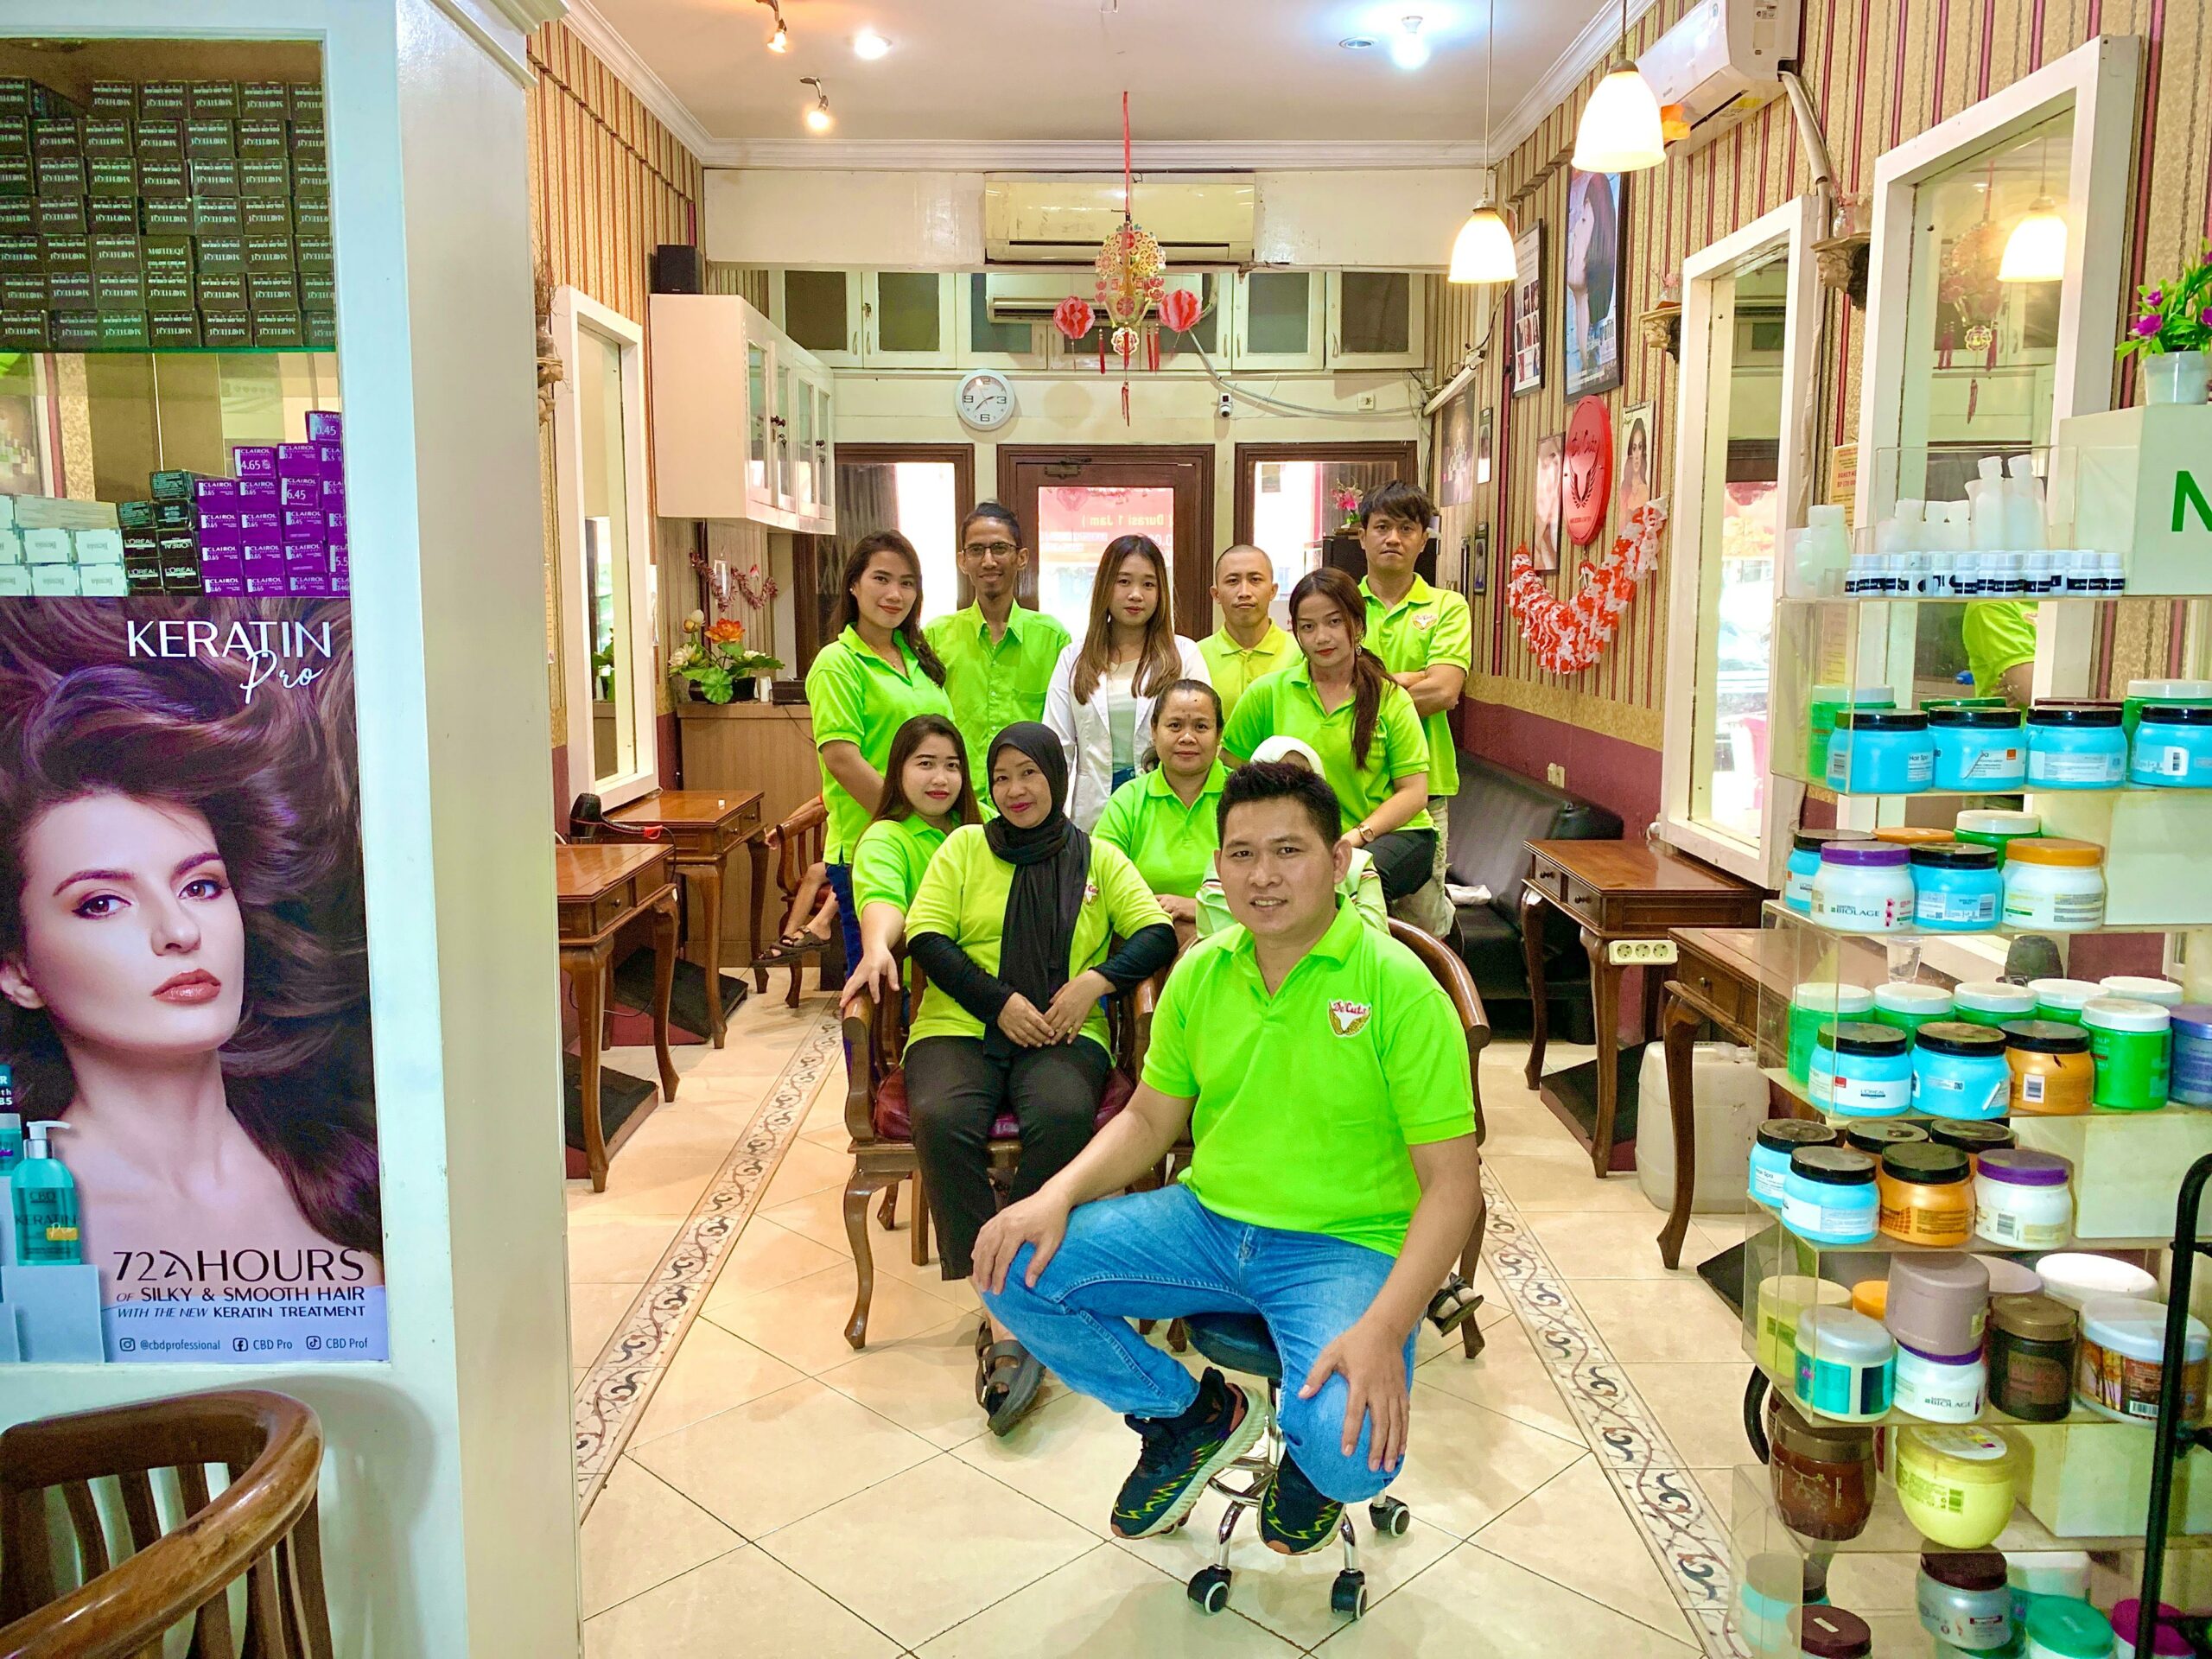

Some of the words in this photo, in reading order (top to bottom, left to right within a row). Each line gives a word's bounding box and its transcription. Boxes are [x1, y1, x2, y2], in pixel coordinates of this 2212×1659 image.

[996, 396, 1007, 404] 3
[980, 413, 990, 422] 6
[316, 425, 337, 435] 0.45
[241, 460, 260, 470] 4.65
[287, 489, 306, 499] 6.45
[127, 620, 332, 658] KERATIN
[239, 649, 324, 704] Pro
[1836, 907, 1880, 917] BIOLAGE
[16, 1214, 77, 1225] KERATIN
[113, 1250, 157, 1281] 72
[196, 1249, 365, 1282] HOURS
[117, 1292, 134, 1302] OF
[141, 1287, 193, 1302] SILKY
[201, 1287, 215, 1302] &
[223, 1287, 309, 1302] SMOOTH
[317, 1286, 365, 1301] HAIR
[118, 1307, 149, 1319] WITH
[155, 1307, 175, 1318] THE
[180, 1306, 208, 1318] NEW
[213, 1306, 272, 1318] KERATIN
[279, 1306, 365, 1318] TREATMENT
[140, 1339, 221, 1352] @cbdprofessional
[253, 1340, 274, 1351] CBD
[277, 1339, 293, 1351] Pro
[326, 1338, 346, 1349] CBD
[350, 1338, 368, 1349] Prof
